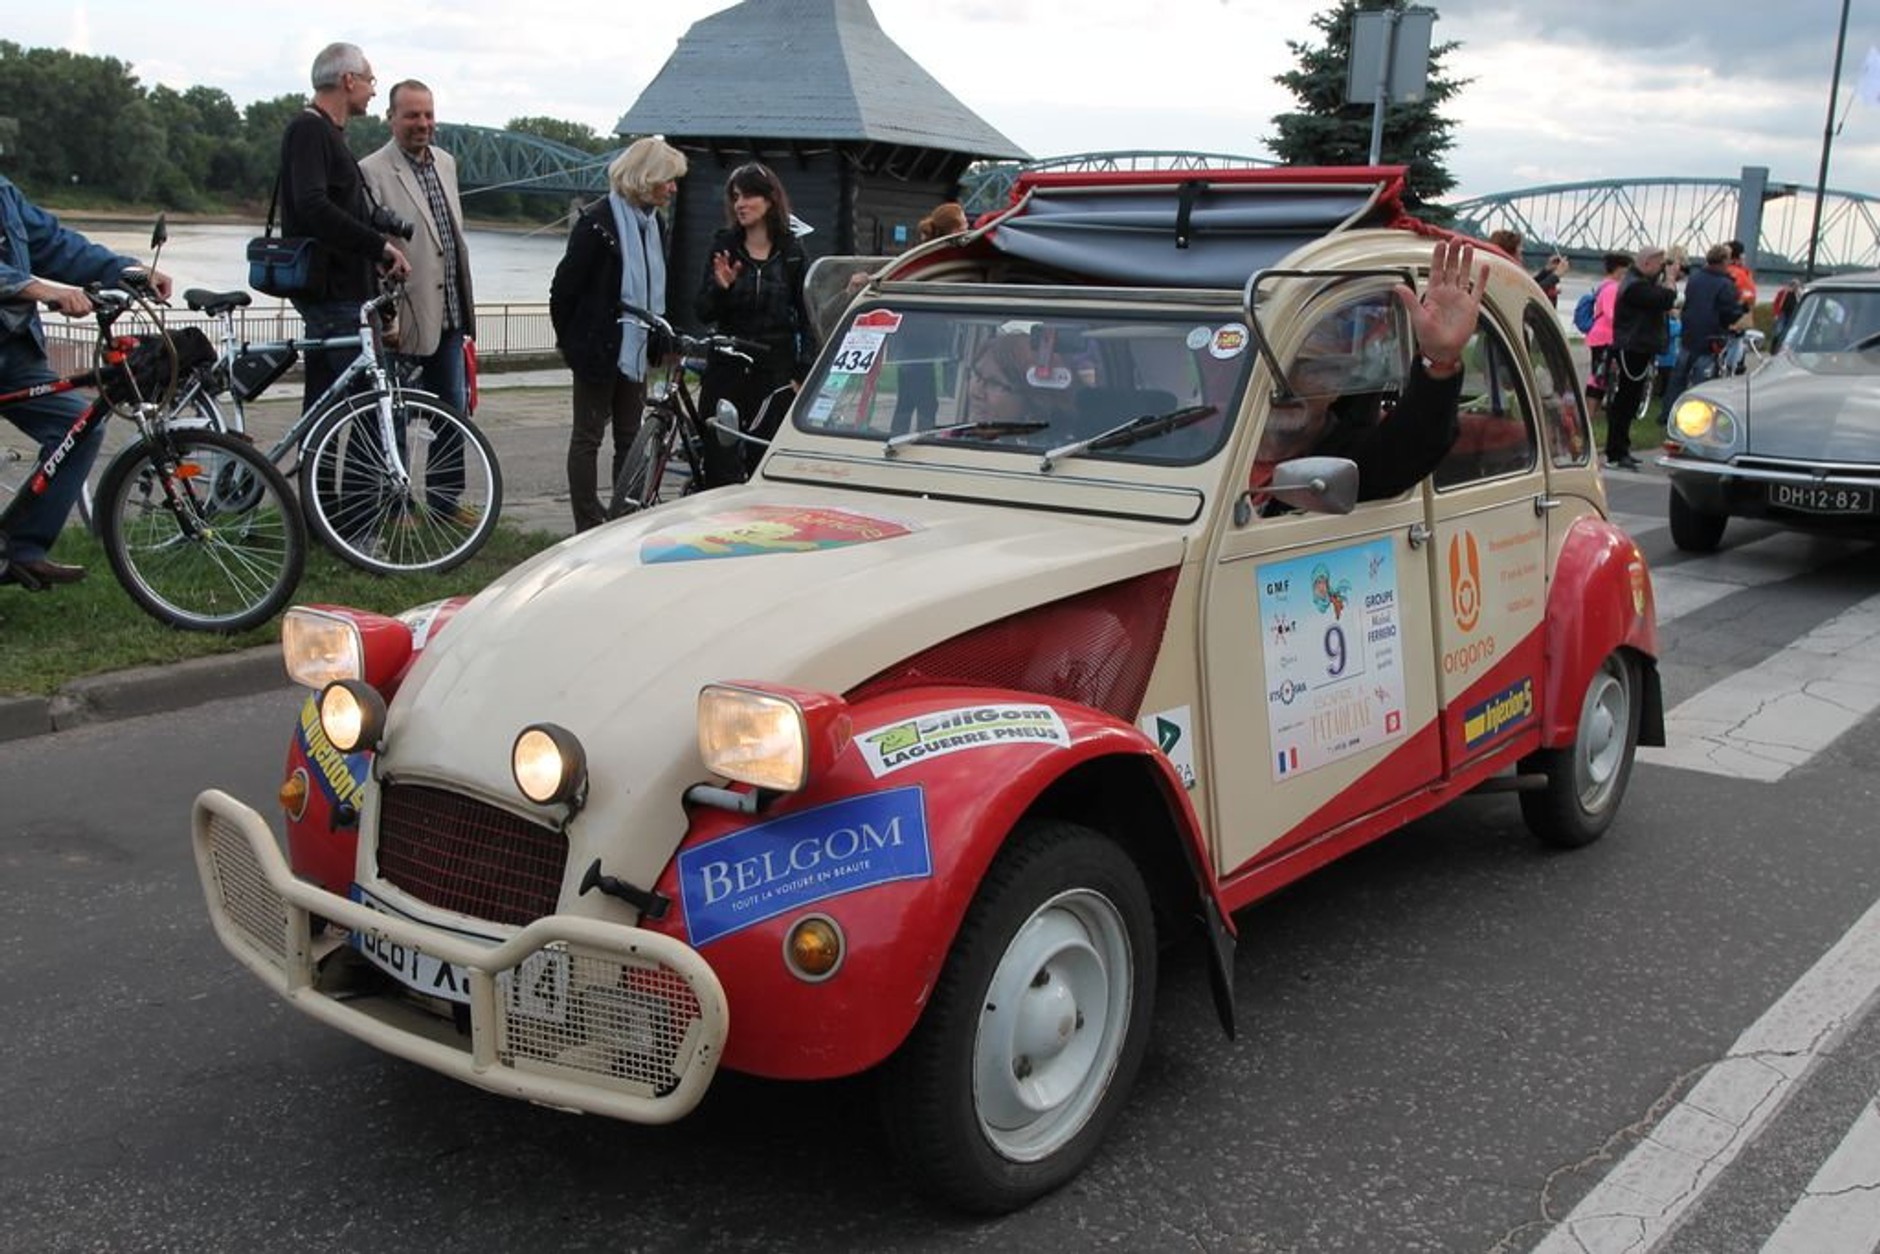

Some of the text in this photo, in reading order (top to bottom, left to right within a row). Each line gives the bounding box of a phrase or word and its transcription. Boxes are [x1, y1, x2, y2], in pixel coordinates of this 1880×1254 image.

[833, 351, 875, 371] 434
[1324, 624, 1347, 676] 9
[882, 727, 1060, 768] LAGUERRE PNEUS
[700, 816, 905, 906] BELGOM
[732, 858, 871, 912] TOUTE LA VOITURE EN BEAUTE
